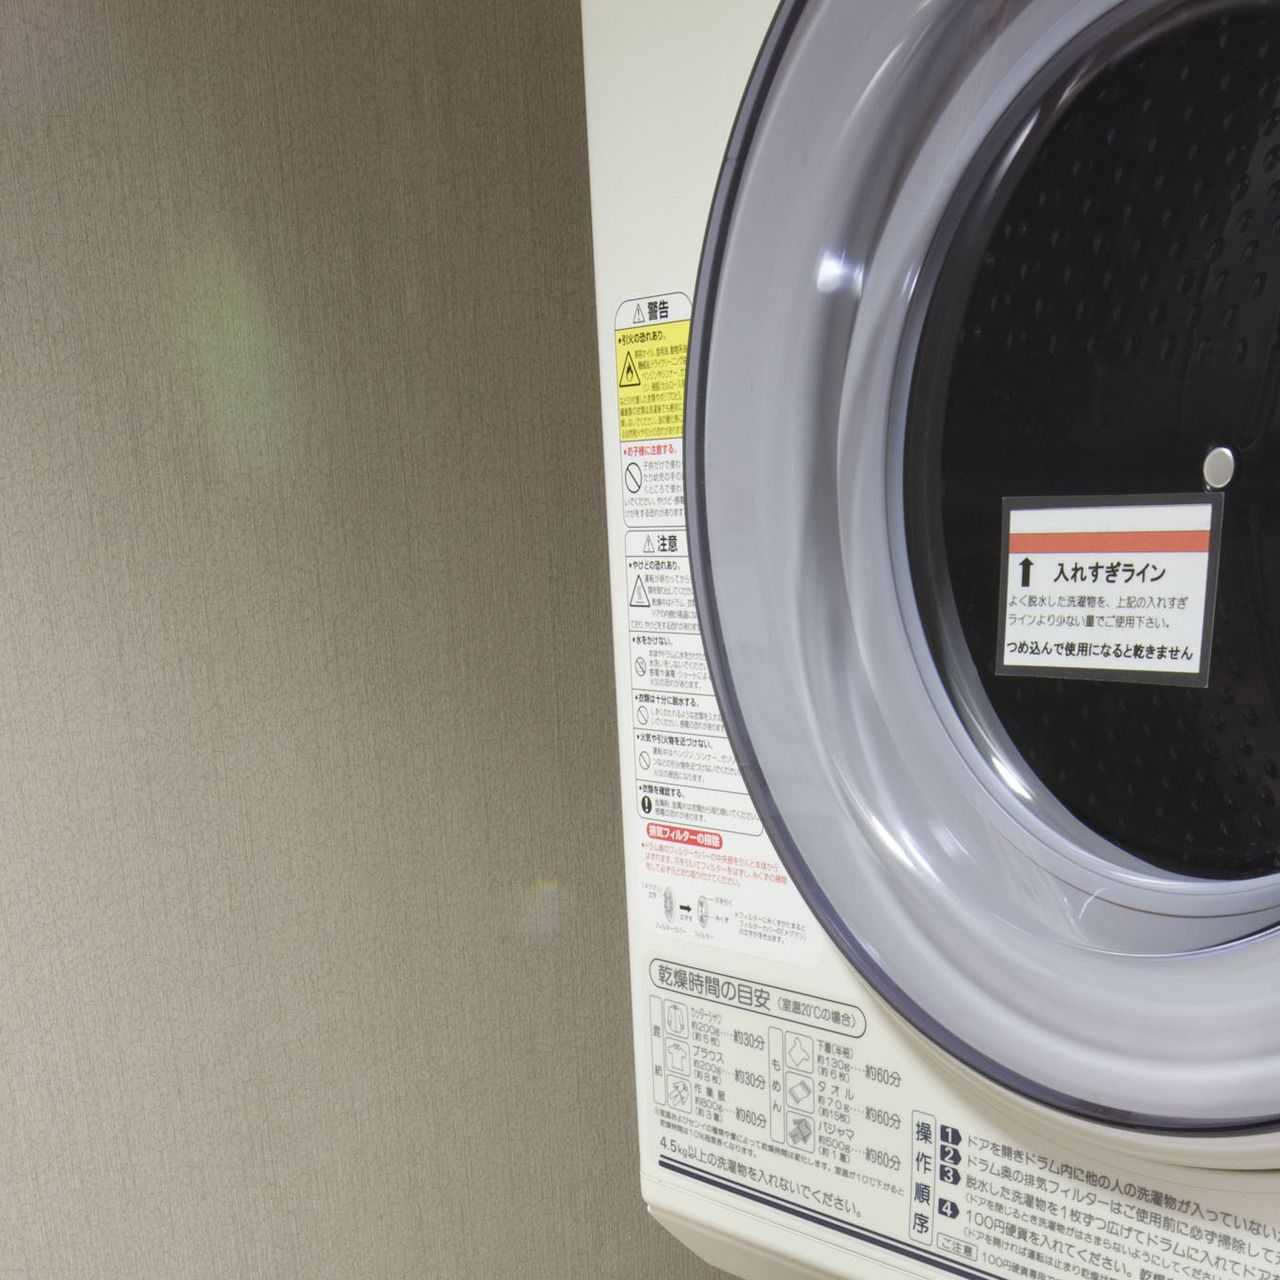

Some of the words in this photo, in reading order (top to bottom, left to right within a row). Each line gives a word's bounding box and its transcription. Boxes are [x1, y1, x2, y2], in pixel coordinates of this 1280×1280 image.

[647, 300, 669, 321] 警告
[627, 444, 677, 458] お子様に注意する。
[657, 535, 678, 553] 注意
[1053, 561, 1166, 583] 入れすぎライン
[1008, 594, 1189, 610] よく脱水した洗濯物を、上記の入れすぎ
[1008, 614, 1170, 629] ラインより少ない量でご使用下さい。
[636, 635, 673, 646] 水をかけない。
[1007, 641, 1193, 661] つめ込んで使用になると乾きません
[638, 693, 699, 708] 衣類は十分に脱水する。
[640, 733, 713, 749] 火気や引火物を近づけない。
[642, 784, 685, 798] 衣類を確認する。
[648, 824, 721, 848] 排気フィルターの掃除
[658, 964, 771, 1011] 乾燥時間の目安
[733, 1029, 765, 1051] 約30分
[693, 1045, 724, 1064] ブラウス
[735, 1069, 766, 1090] 約30分
[771, 1059, 782, 1113] もめん
[865, 1064, 901, 1088] 約60分
[817, 1081, 854, 1101] タオル
[736, 1107, 767, 1129] 約60分
[865, 1106, 901, 1130] 約60分
[819, 1121, 855, 1140] パジャマ
[865, 1147, 902, 1172] 約60分
[660, 1136, 862, 1218] 4.5kg以上の洗濯物を入れないでください。
[912, 1120, 933, 1236] 操作順序
[942, 1239, 973, 1256] ご注意
